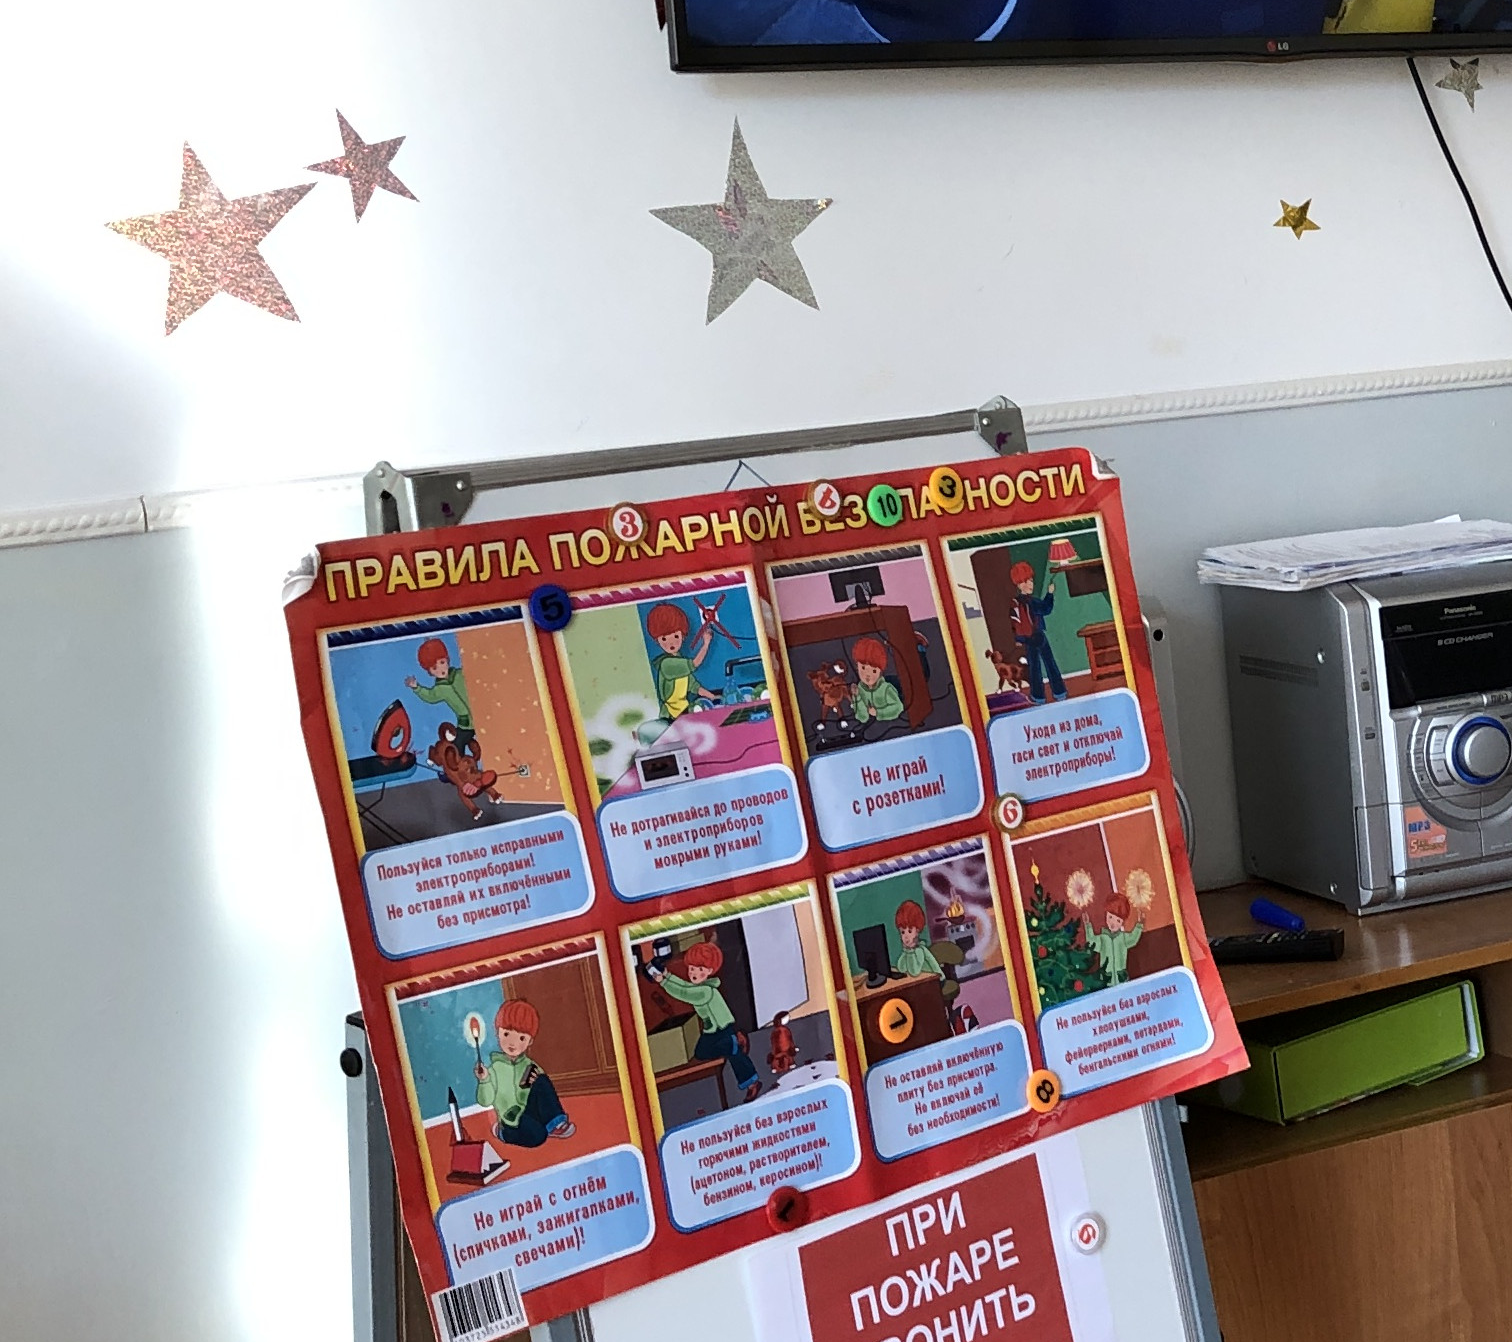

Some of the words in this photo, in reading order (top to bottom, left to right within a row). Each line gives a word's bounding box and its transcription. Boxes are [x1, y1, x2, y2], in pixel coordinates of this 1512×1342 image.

[325, 538, 540, 601] ПРАВИЛА
[1011, 748, 1035, 765] гаси
[1037, 743, 1060, 760] свет
[1062, 740, 1071, 753] и
[1073, 726, 1123, 751] отключай
[1023, 721, 1056, 743] Уходя
[1059, 720, 1072, 733] из
[1074, 714, 1103, 732] дома,
[860, 765, 882, 787] Не
[886, 755, 928, 783] играй
[1025, 749, 1115, 782] электроприборы!
[609, 821, 628, 838] Не
[631, 805, 711, 835] дотрагивайся
[714, 801, 728, 818] до
[730, 788, 789, 814] проводов
[852, 798, 862, 815] с
[865, 774, 946, 817] розетками!
[644, 839, 652, 851] и
[655, 813, 764, 849] электроприборов
[1408, 821, 1431, 833] MP3
[377, 855, 442, 881] Пользуйся
[446, 847, 488, 866] только
[490, 829, 565, 855] исправными
[654, 845, 710, 870] мокрыми
[713, 830, 763, 859] руками!
[386, 903, 404, 921] Не
[407, 890, 465, 915] оставляй
[469, 889, 485, 902] их
[488, 868, 571, 897] включёнными
[415, 852, 535, 893] электроприборами!
[437, 913, 459, 929] без
[462, 893, 532, 925] присмотра!
[1055, 1016, 1069, 1031] Не
[1071, 1002, 1117, 1025] пользуйся
[1119, 996, 1134, 1011] без
[1136, 983, 1179, 1007] взрослых
[1092, 1011, 1150, 1037] хлопушками,
[884, 1074, 898, 1089] Не
[900, 1059, 944, 1083] оставляй
[946, 1040, 1004, 1069] включённую
[897, 1086, 925, 1104] плиту
[927, 1077, 945, 1093] без
[947, 1061, 998, 1090] присмотра.
[907, 1121, 924, 1137] без
[927, 1093, 1001, 1131] необходимости!
[914, 1101, 928, 1116] Не
[930, 1086, 971, 1109] включай
[680, 1140, 695, 1156] Не
[698, 1122, 752, 1149] пользуйся
[755, 1115, 774, 1131] без
[776, 1098, 829, 1124] взрослых
[698, 1145, 750, 1170] горючими
[752, 1121, 817, 1152] жидкостями
[690, 1165, 747, 1195] (ацетоном,
[749, 1137, 831, 1175] растворителем,
[703, 1180, 757, 1207] бензином,
[759, 1152, 823, 1187] керосином)!
[473, 1212, 494, 1232] Не
[499, 1194, 544, 1222] играй
[548, 1192, 557, 1206] с
[562, 1175, 608, 1202] огнём
[885, 1190, 967, 1257] ПРИ
[453, 1225, 532, 1269] (спичками,
[537, 1189, 641, 1235] зажигалками,
[515, 1225, 586, 1267] свечами)!
[849, 1226, 1020, 1332] ПОЖАРЕ
